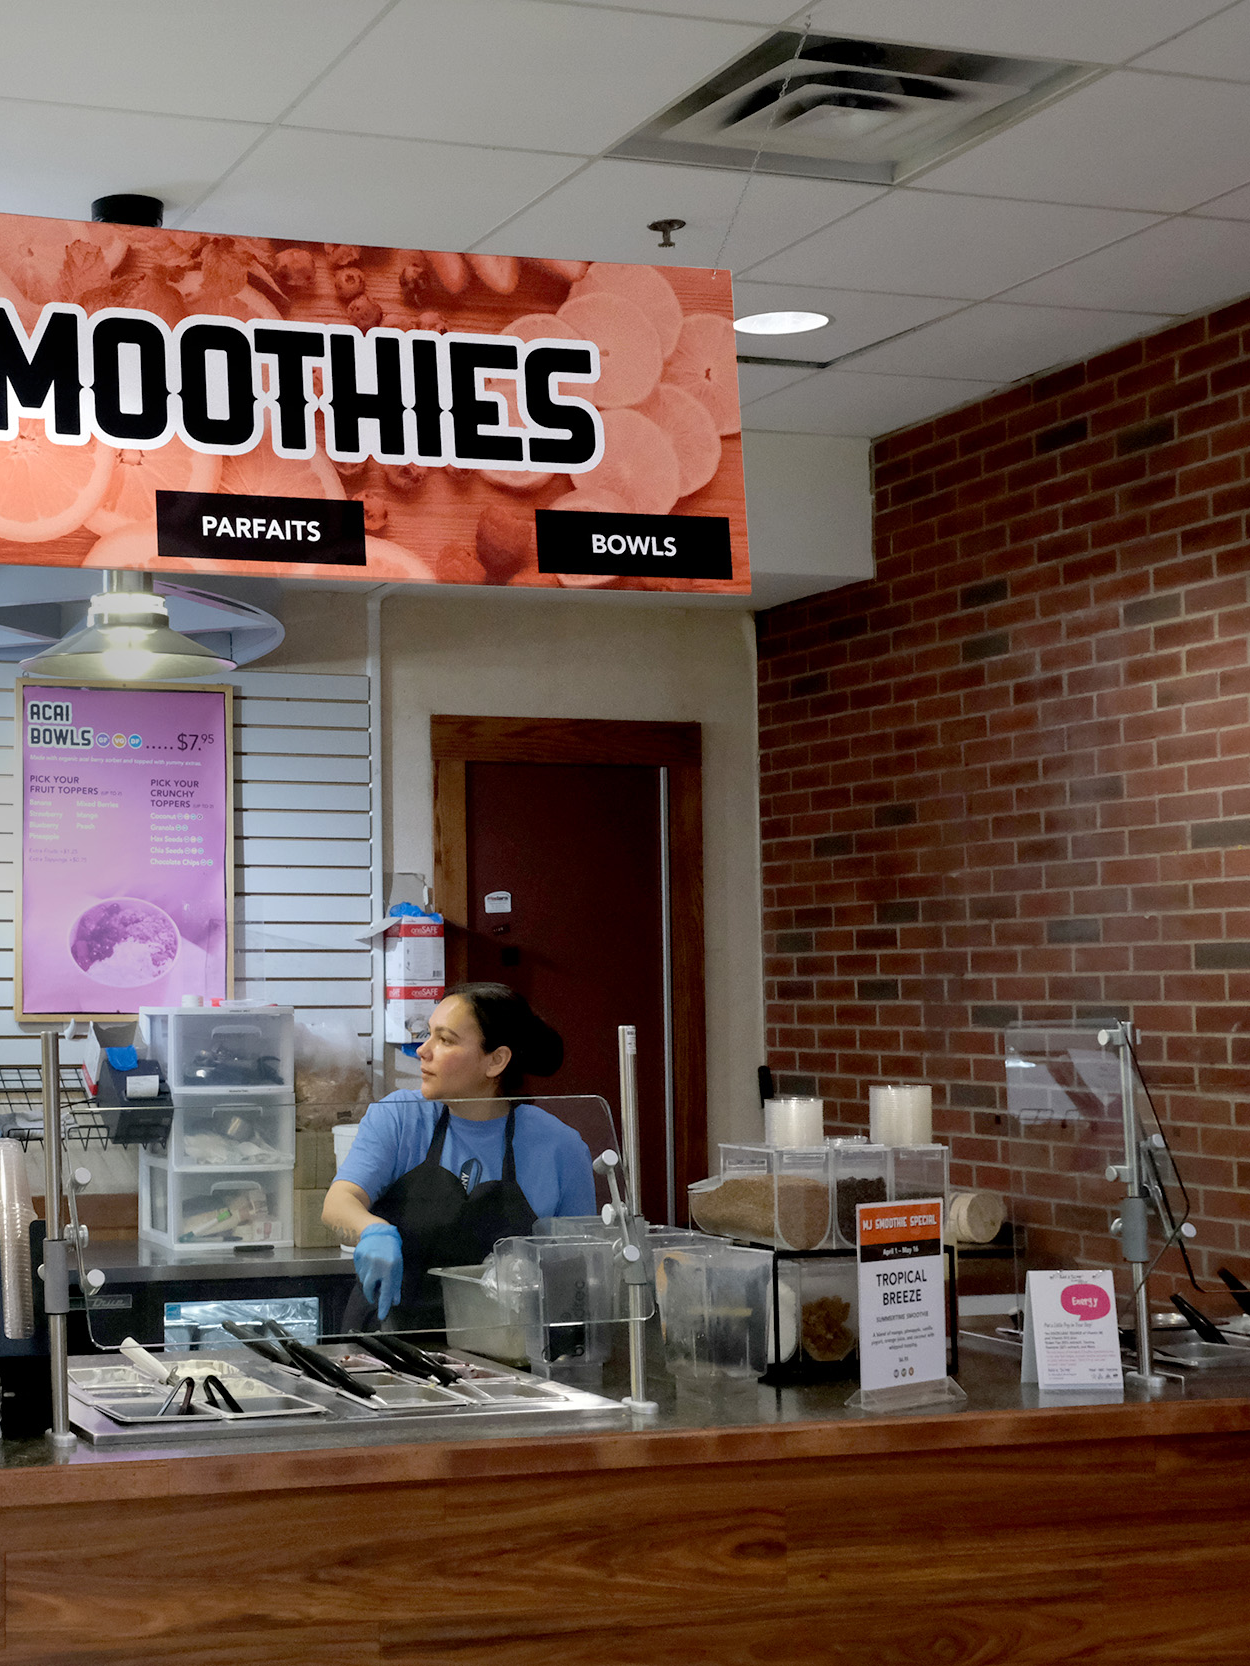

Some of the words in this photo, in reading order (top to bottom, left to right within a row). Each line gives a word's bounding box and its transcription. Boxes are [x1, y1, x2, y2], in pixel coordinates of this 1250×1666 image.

[201, 516, 321, 542] PARFAITS
[591, 533, 677, 557] BOWLS
[30, 704, 70, 722] ACAI
[30, 728, 92, 746] BOWLS
[178, 732, 215, 752] $7.95
[30, 775, 50, 783] PICK
[53, 776, 80, 784] YOUR
[150, 779, 171, 788] PICK
[174, 780, 200, 788] YOUR
[30, 786, 54, 794] FRUIT
[58, 786, 98, 795] TOPPERS
[150, 790, 195, 798] CRUNCHY
[150, 800, 190, 808] TOPPERS
[876, 1217, 908, 1230] SMOOTHIE
[910, 1214, 937, 1227] SPECIAL
[876, 1270, 927, 1286] TROPICAL
[882, 1288, 922, 1306] BREEZE
[1072, 1296, 1098, 1308] Energy
